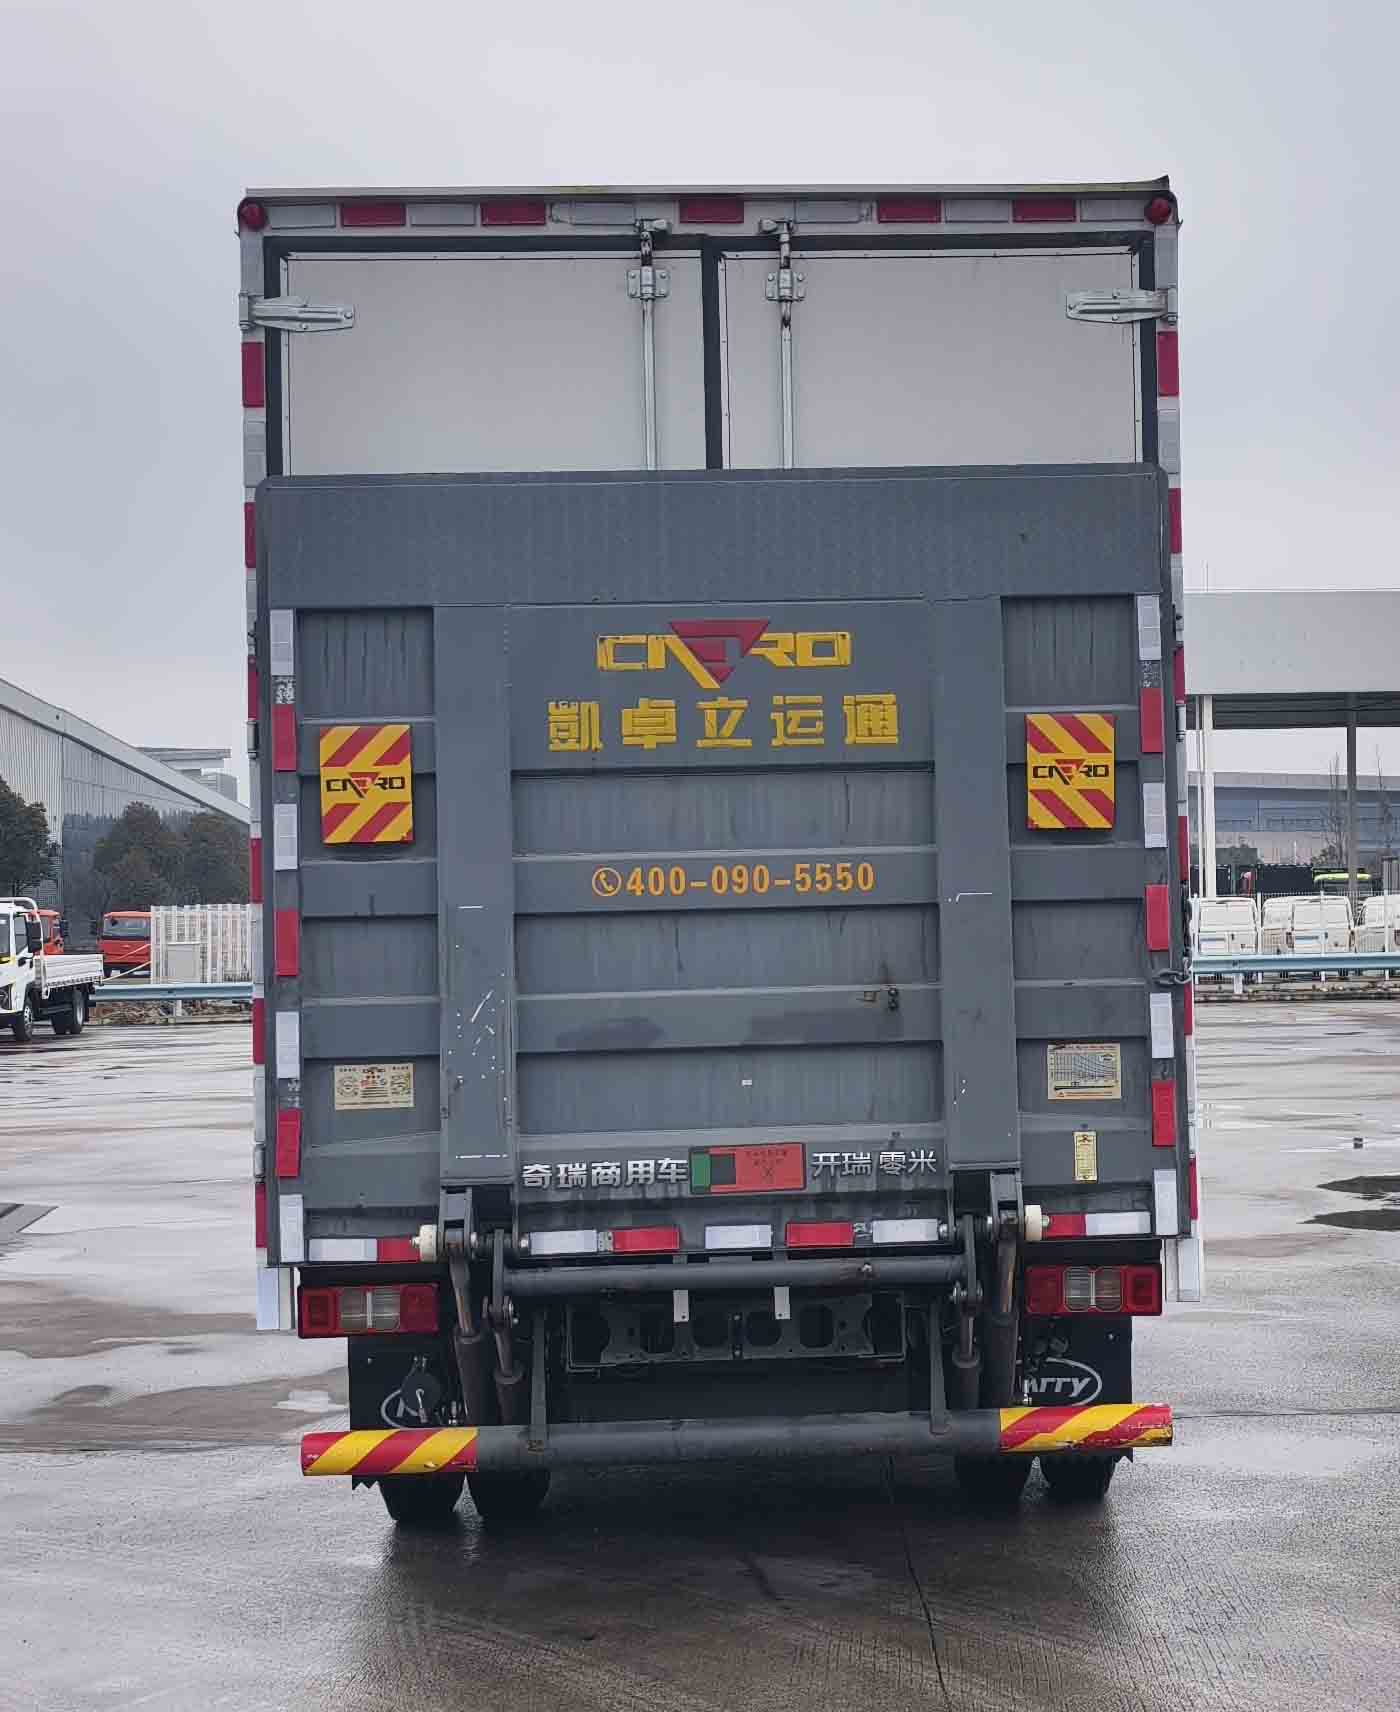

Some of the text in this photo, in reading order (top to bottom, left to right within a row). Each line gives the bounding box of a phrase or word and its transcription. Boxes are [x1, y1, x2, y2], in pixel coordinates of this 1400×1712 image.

[548, 694, 899, 752] 凯卓立运通
[625, 863, 875, 896] 400-090-5550
[521, 1157, 689, 1190] 奇瑞商用车
